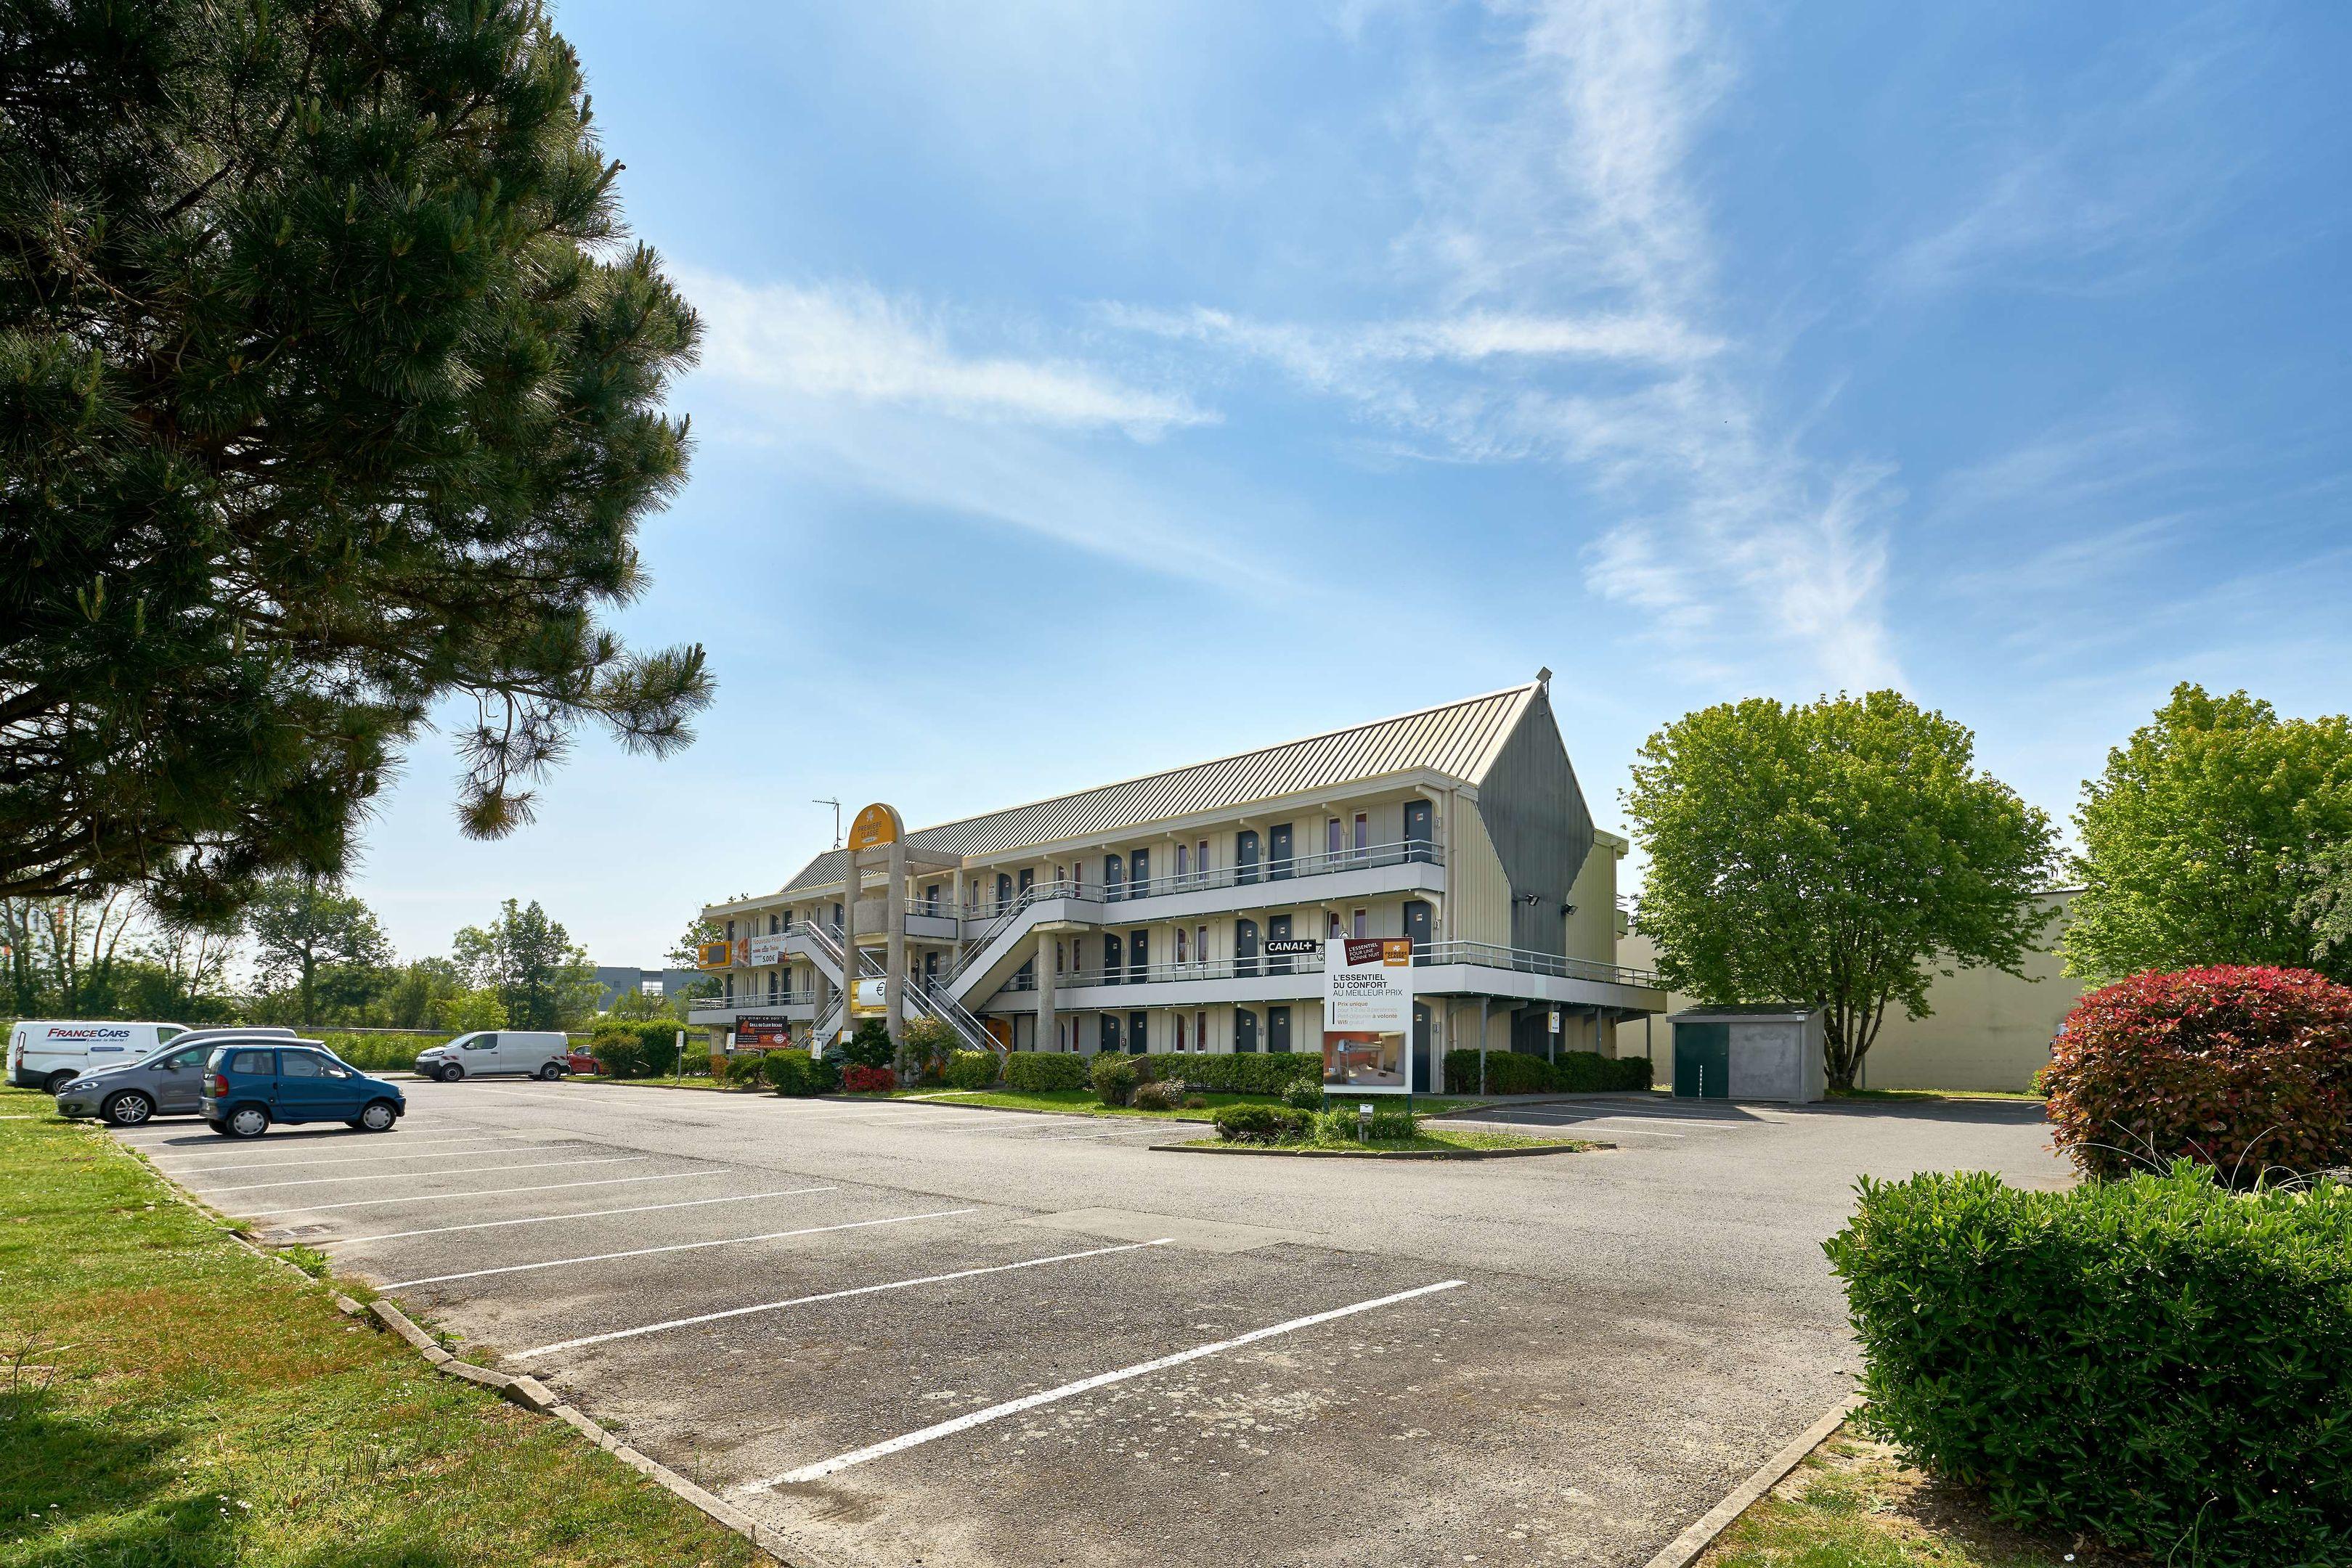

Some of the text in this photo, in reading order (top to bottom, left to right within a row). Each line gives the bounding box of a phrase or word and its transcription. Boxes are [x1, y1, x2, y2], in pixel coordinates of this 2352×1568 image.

[860, 829, 879, 838] CLASSE
[1268, 942, 1312, 951] CANAL+
[1348, 942, 1379, 952] L'ESSENTIEL
